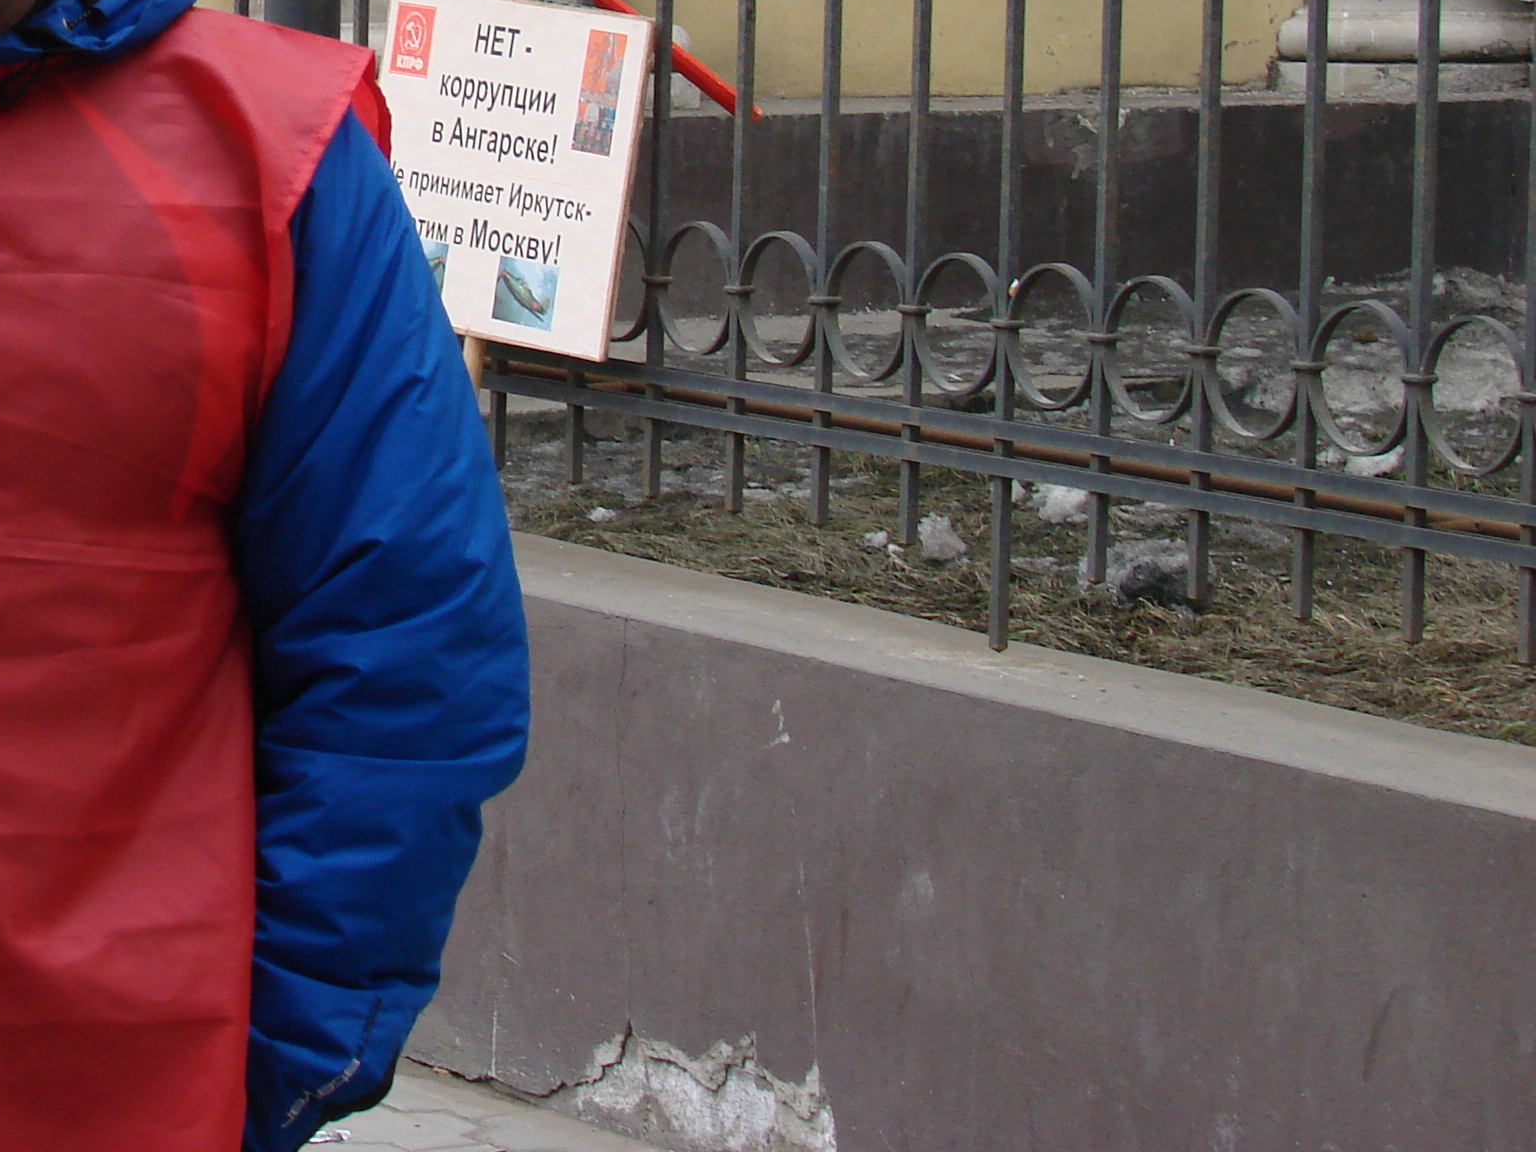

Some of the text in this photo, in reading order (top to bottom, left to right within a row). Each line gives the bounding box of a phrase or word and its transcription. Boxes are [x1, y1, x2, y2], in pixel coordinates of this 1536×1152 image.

[474, 23, 521, 58] НЕТ
[396, 54, 424, 72] КПРФ
[439, 74, 557, 115] коррупции
[431, 117, 558, 165] в Ангарске!
[409, 170, 504, 205] принимает
[508, 182, 592, 222] Иркутск-
[413, 218, 562, 265] тим в Москву!
